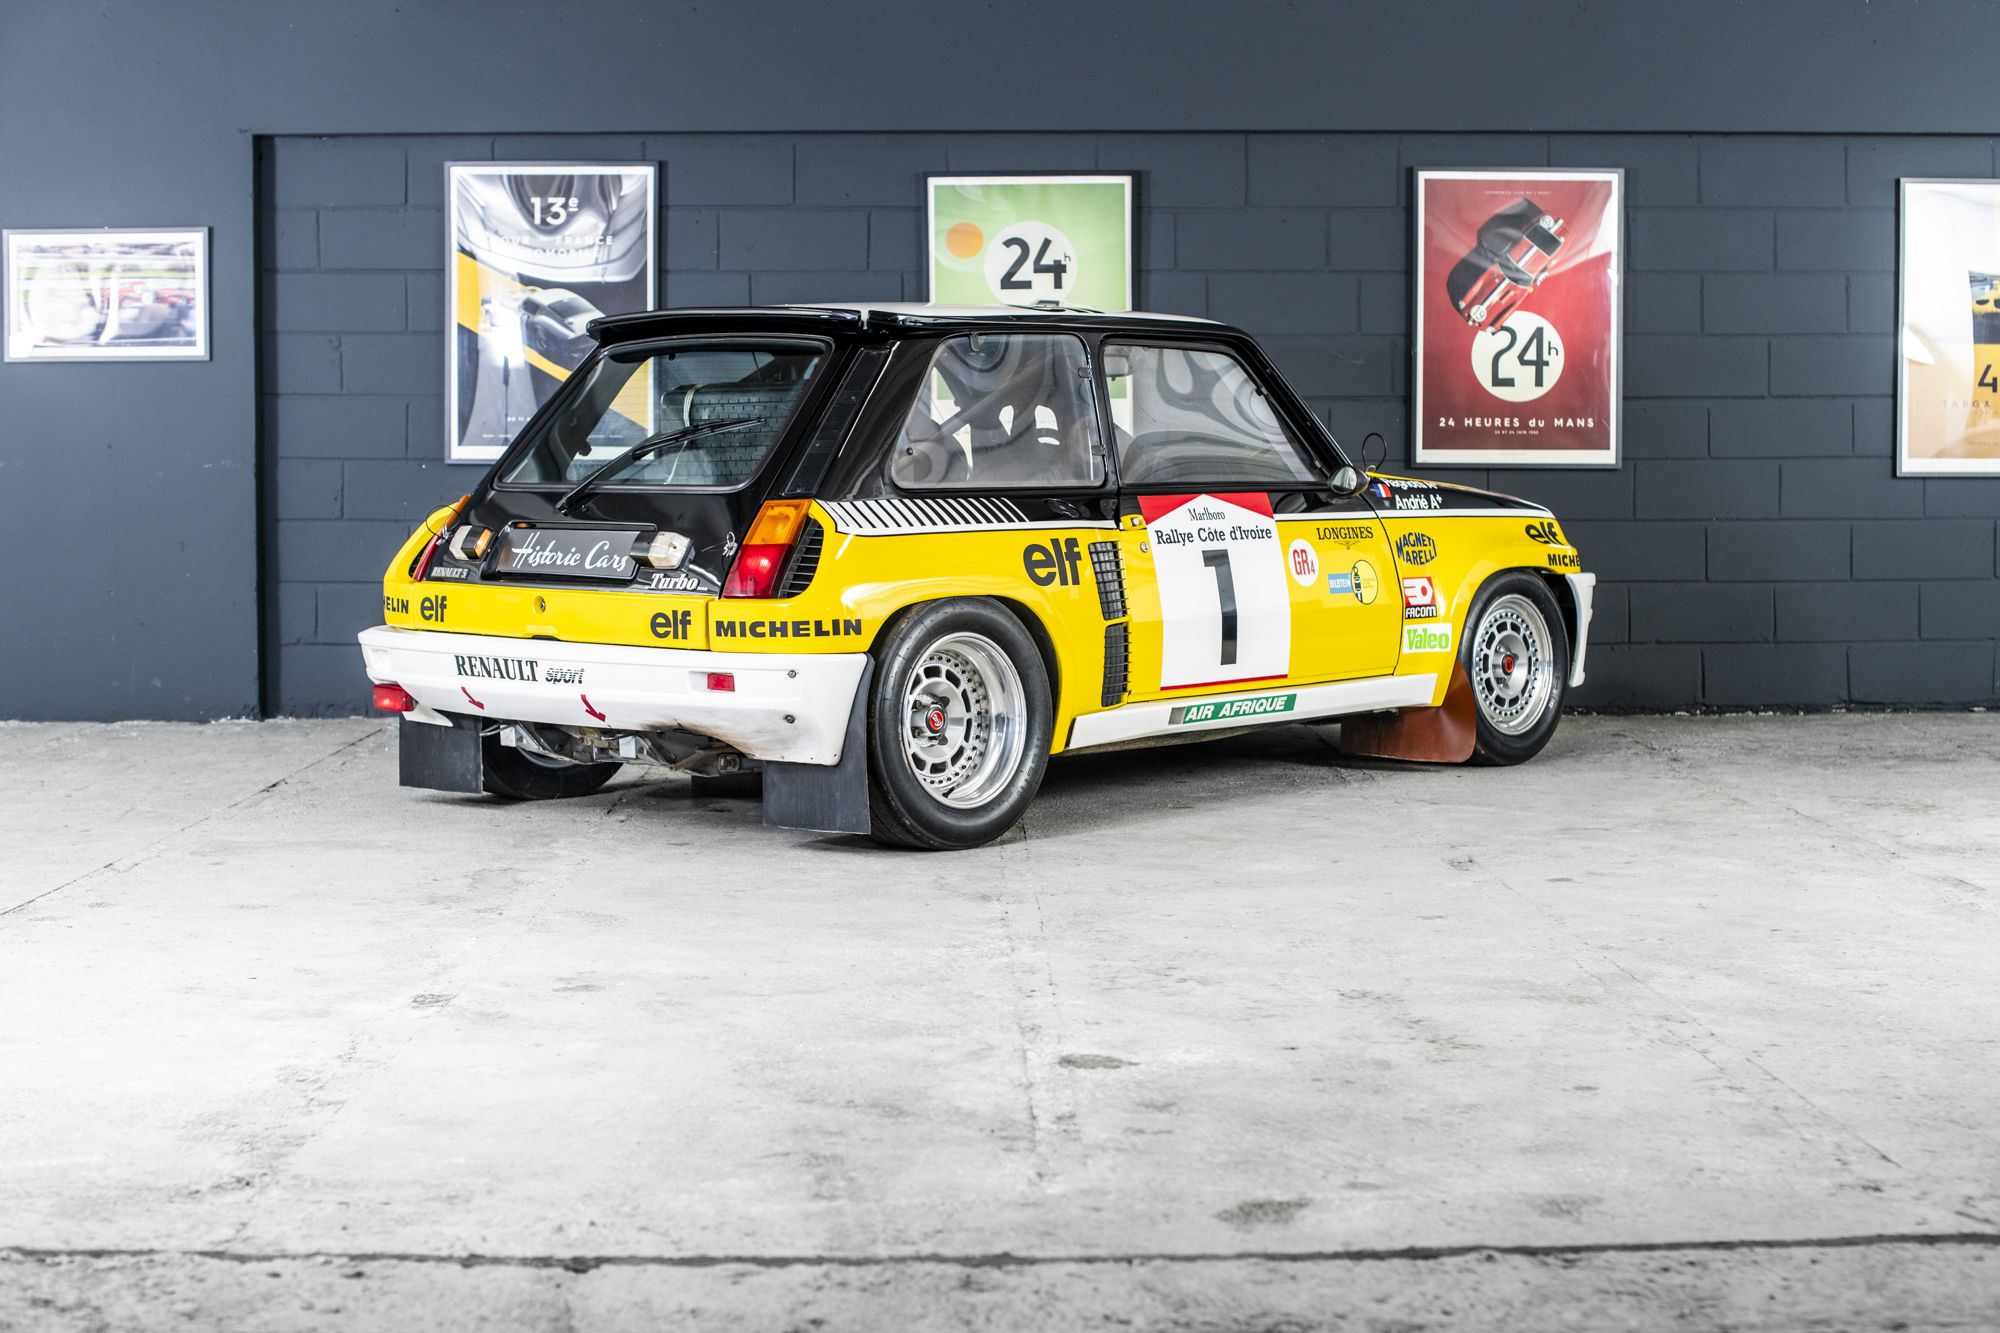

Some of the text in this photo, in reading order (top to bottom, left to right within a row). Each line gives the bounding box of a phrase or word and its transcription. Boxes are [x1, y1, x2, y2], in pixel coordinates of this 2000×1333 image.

[1439, 417, 1594, 428] 24 HEURES du MANS
[1188, 508, 1226, 521] Marlboro
[1155, 525, 1273, 546] Rallye Côte d'Ivoire
[1316, 527, 1374, 540] LONGINES
[1395, 532, 1437, 554] MAGNETI
[1525, 521, 1564, 546] elf
[512, 531, 629, 572] Historic Cars
[1024, 538, 1082, 586] elf
[1395, 546, 1437, 566] MARELLI
[431, 566, 469, 579] RENAULT 5
[648, 573, 700, 591] Turbo
[420, 595, 447, 622] elf
[1202, 549, 1237, 666] 1
[1405, 605, 1437, 618] FACOM
[650, 609, 692, 640] elf
[715, 618, 862, 638] MICHELIN
[1406, 628, 1450, 650] Valeo
[454, 655, 585, 685] RENAULT sport
[1184, 696, 1288, 722] AIR AFRIQUE
